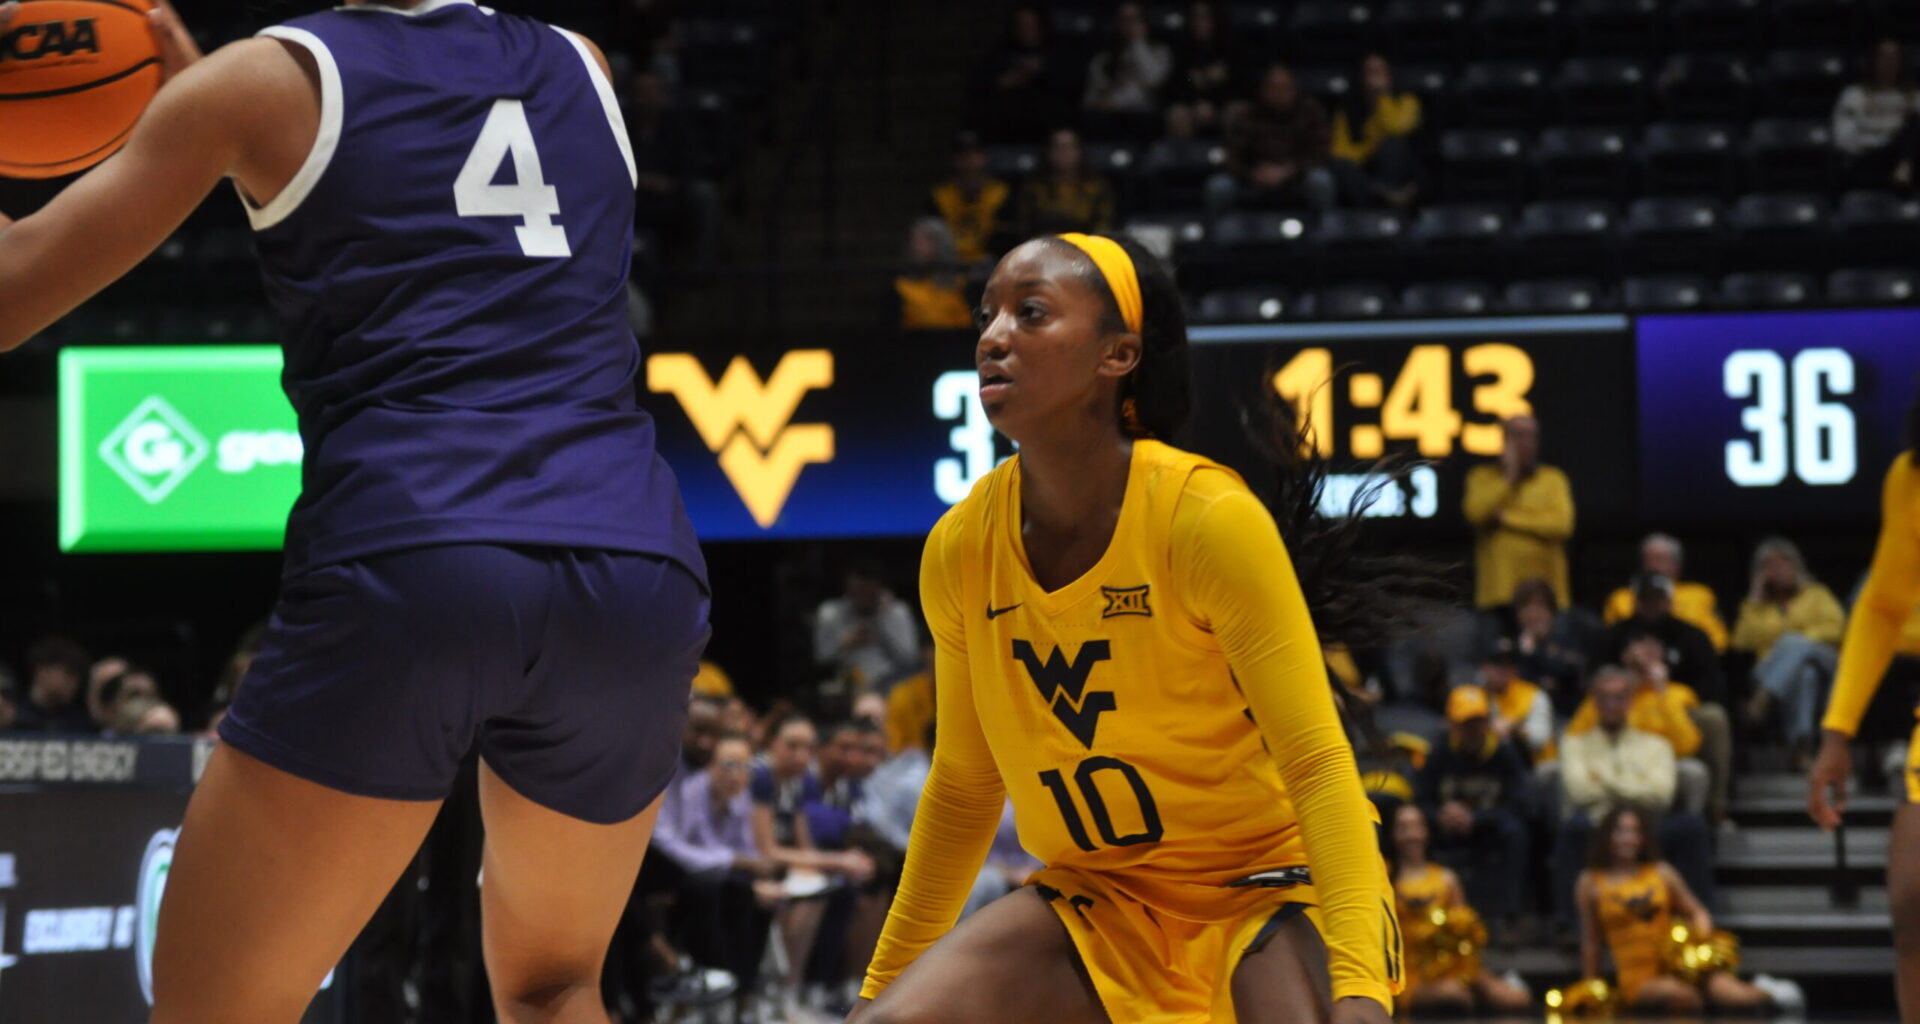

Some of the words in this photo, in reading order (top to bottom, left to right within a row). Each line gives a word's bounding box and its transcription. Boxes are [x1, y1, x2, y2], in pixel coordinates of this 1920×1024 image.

[454, 101, 571, 257] 4
[1272, 344, 1535, 458] 1:43
[1723, 348, 1858, 486] 36
[1039, 757, 1163, 851] 10
